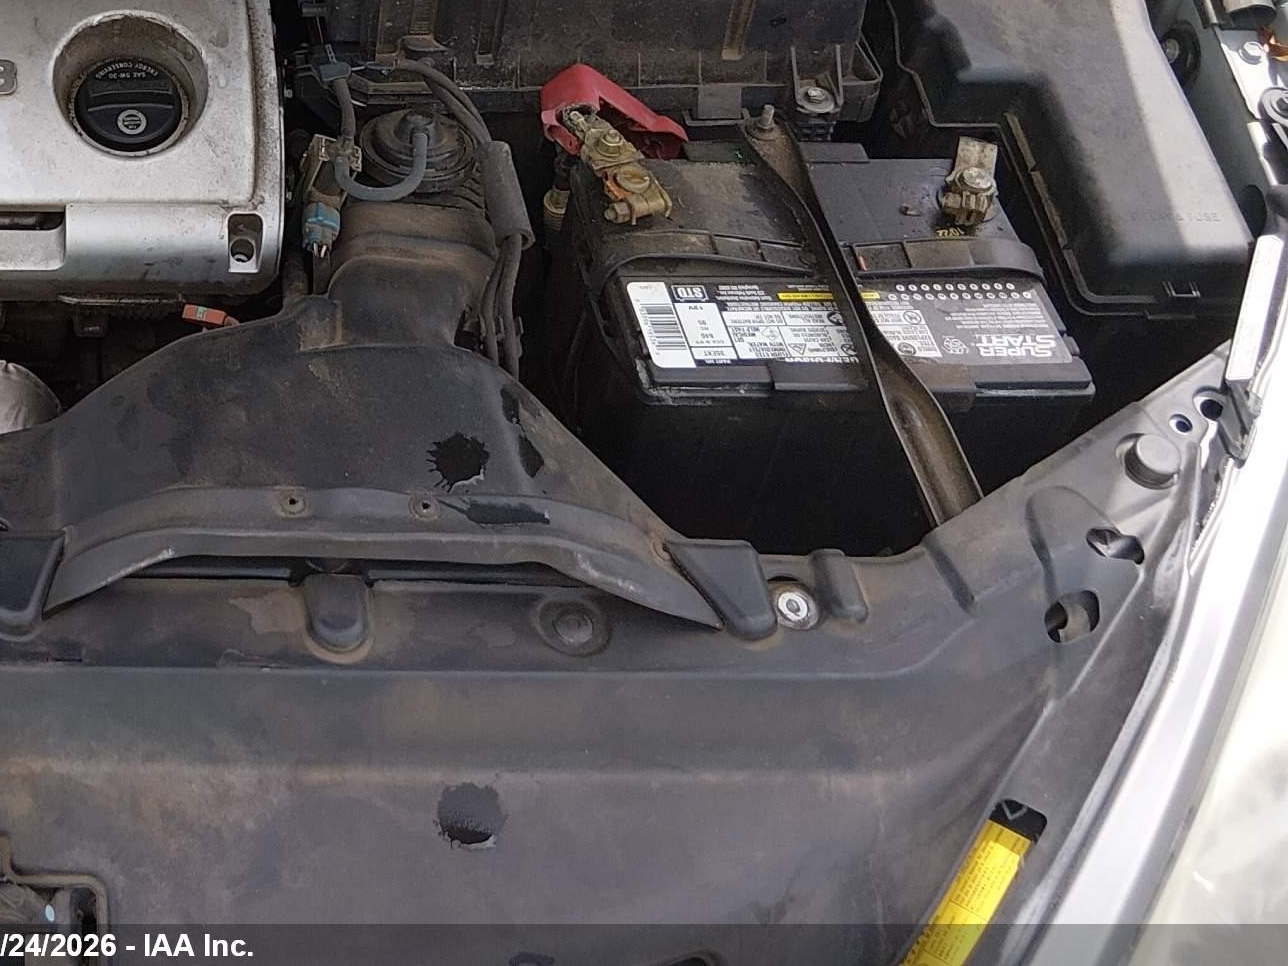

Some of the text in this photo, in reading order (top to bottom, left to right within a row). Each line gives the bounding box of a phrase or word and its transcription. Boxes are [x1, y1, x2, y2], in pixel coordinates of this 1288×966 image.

[95, 62, 158, 79] ENERGY CONSERVING
[677, 286, 702, 298] STD
[975, 335, 1056, 346] START
[978, 346, 1053, 357] SUPER
